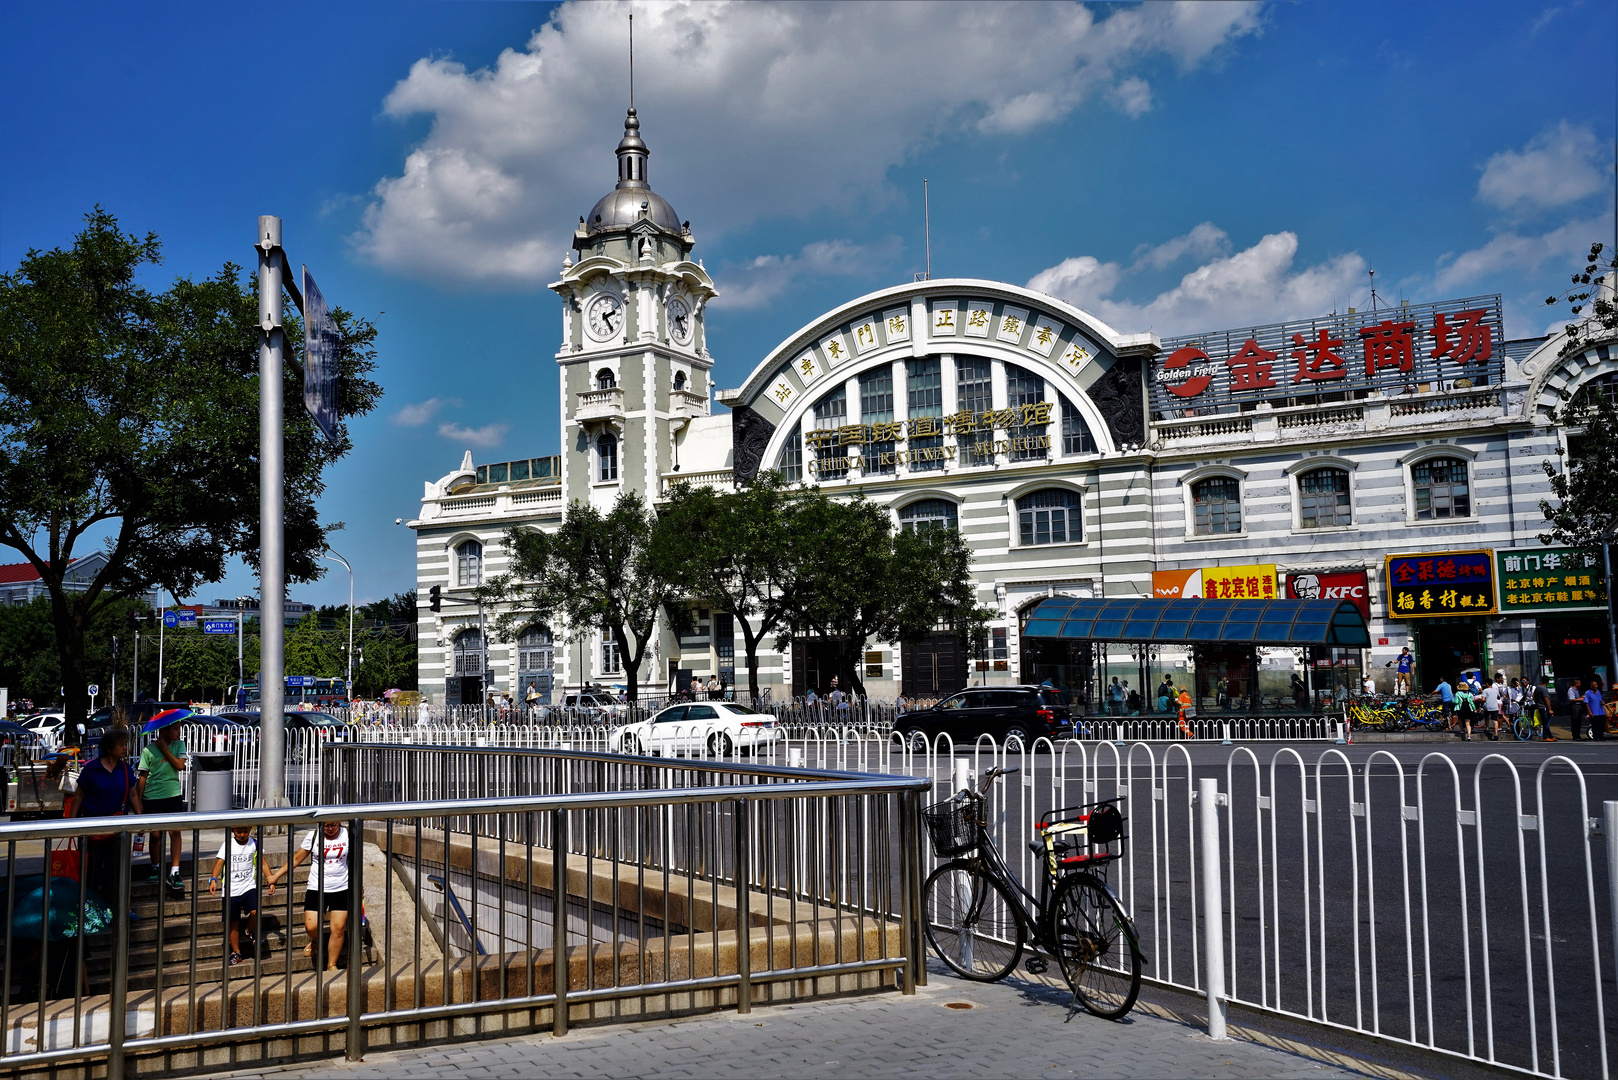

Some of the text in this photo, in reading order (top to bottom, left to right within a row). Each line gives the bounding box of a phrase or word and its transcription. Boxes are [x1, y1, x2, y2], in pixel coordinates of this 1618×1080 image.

[1225, 309, 1492, 391] 金达商场
[1157, 364, 1219, 380] Golden Field
[805, 400, 1054, 450] 中国铁道博物馆
[808, 434, 1052, 473] CHINA RAILWAY MUSEUM
[1205, 576, 1260, 599] 鑫龙宾馆
[1324, 586, 1363, 599] KFC
[1506, 577, 1558, 589] 北京特产
[1507, 592, 1568, 604] 老北京布鞋
